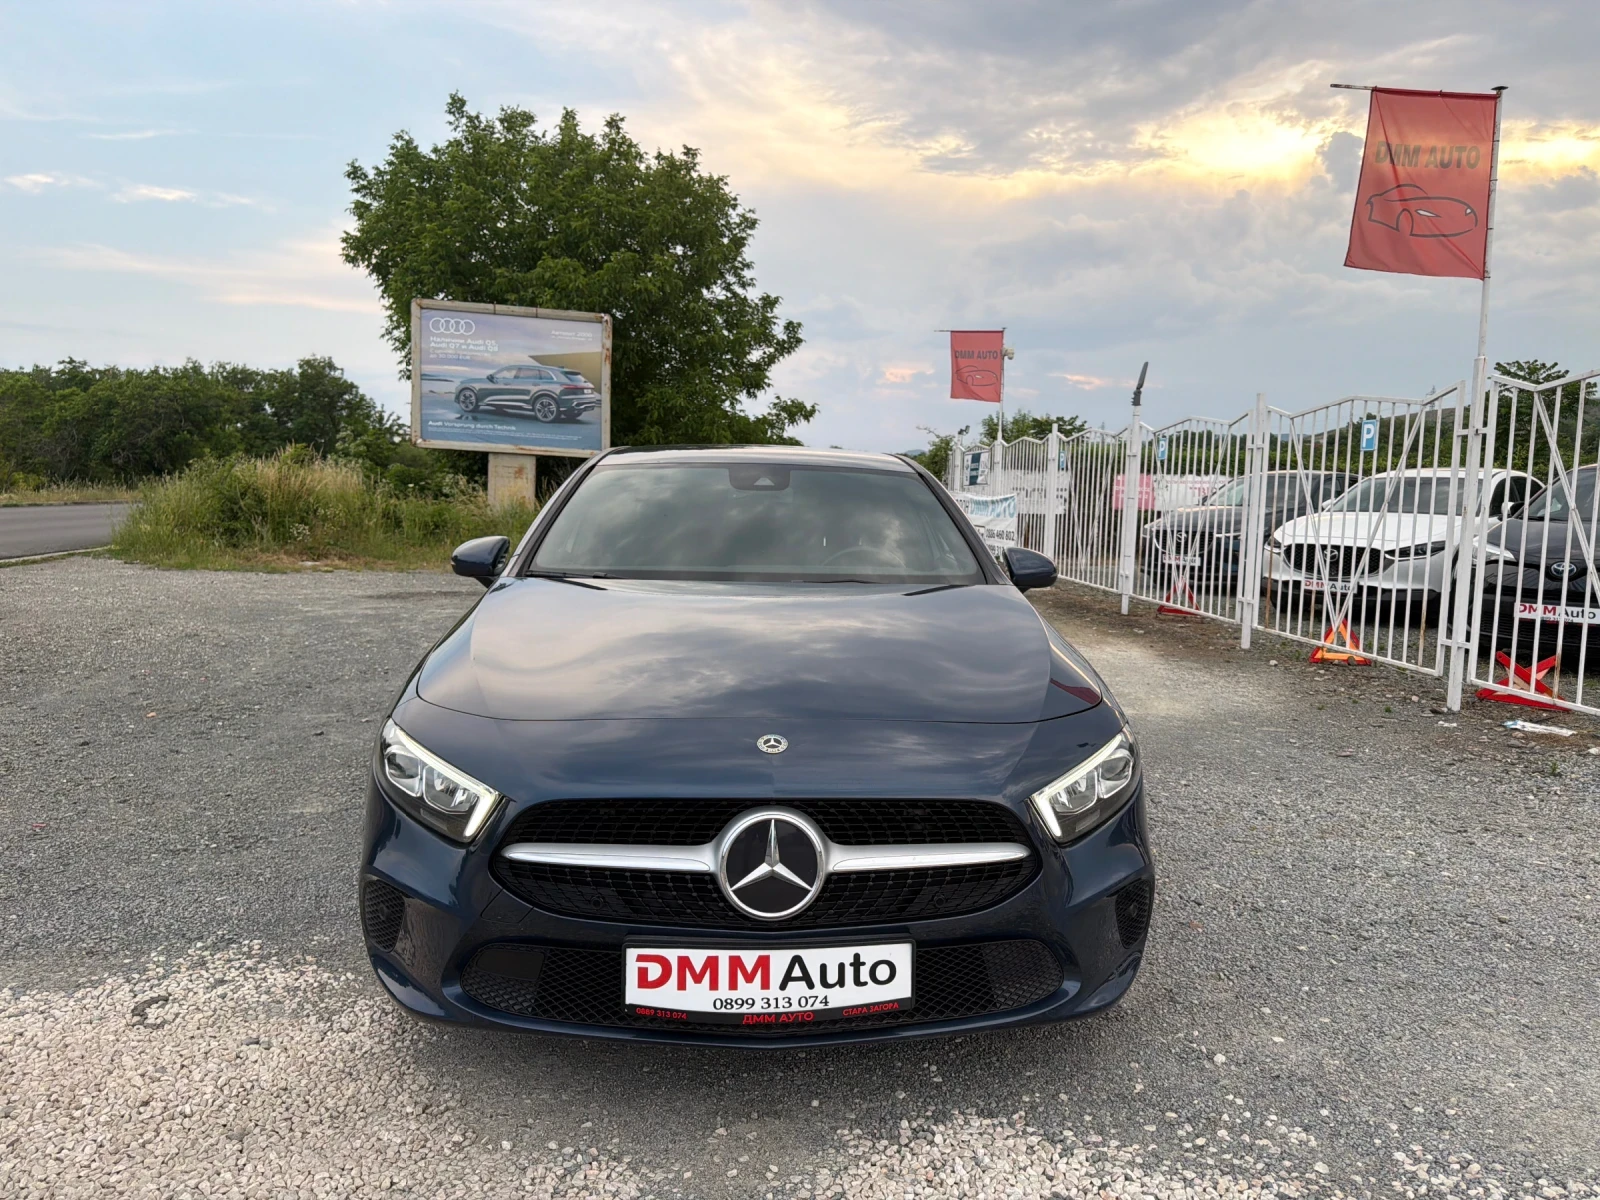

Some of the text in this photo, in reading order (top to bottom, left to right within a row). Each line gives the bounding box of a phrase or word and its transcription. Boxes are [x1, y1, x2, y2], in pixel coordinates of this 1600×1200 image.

[1374, 141, 1480, 170] DMM AUTO
[955, 350, 999, 360] DMM AUTO
[444, 421, 475, 429] Vorsprung
[1362, 423, 1375, 448] P
[1158, 440, 1166, 458] P
[1518, 603, 1557, 616] DMM
[635, 952, 897, 992] DMM Auto
[713, 994, 830, 1011] 0899 313 074
[842, 1002, 899, 1016] СТАРА ЗАГОРА
[656, 1009, 671, 1018] 313
[672, 1012, 687, 1020] 074
[742, 1011, 815, 1025] ДММ АУТО
